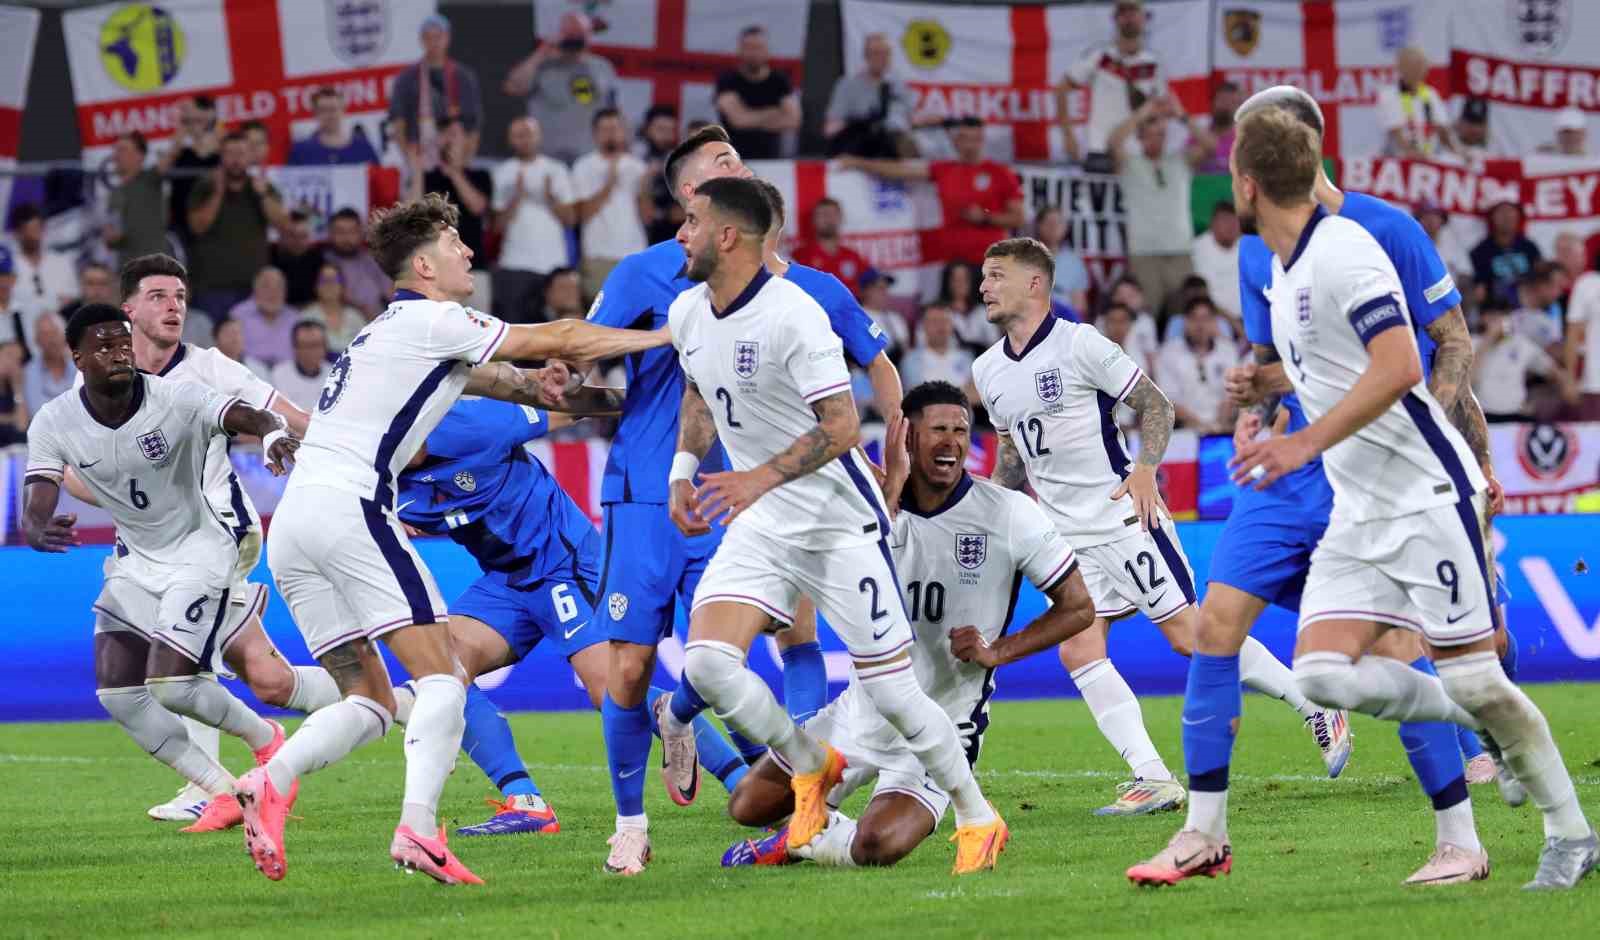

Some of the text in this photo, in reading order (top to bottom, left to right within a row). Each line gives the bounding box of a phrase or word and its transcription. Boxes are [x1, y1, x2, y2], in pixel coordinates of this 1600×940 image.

[1466, 56, 1600, 107] SAFFR
[92, 90, 277, 136] MANSELD
[1344, 158, 1598, 216] BARNEY
[715, 387, 740, 427] 2
[1017, 416, 1052, 458] 12
[129, 478, 150, 510] 6
[1124, 550, 1166, 594] 12
[1435, 560, 1460, 604] 9
[185, 595, 209, 623] 6
[551, 582, 577, 622] 6
[859, 576, 888, 621] 2
[907, 580, 945, 624] 10
